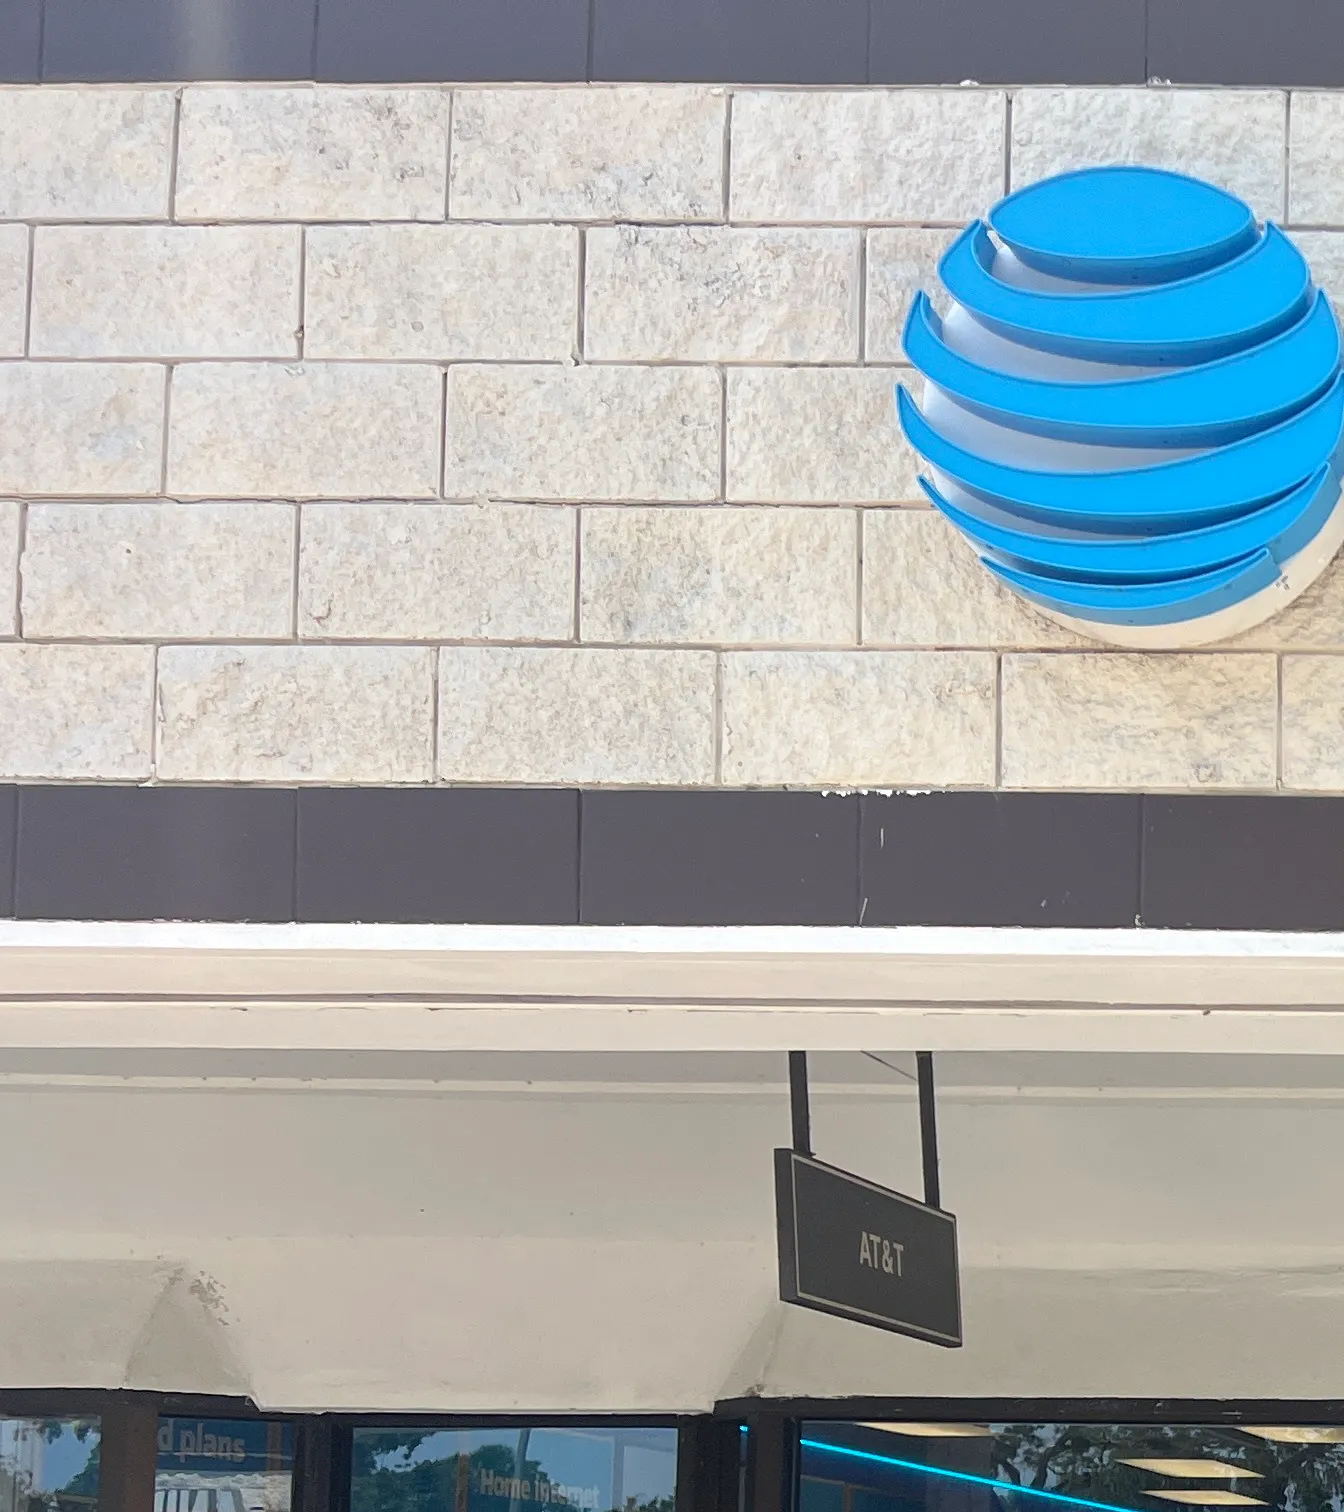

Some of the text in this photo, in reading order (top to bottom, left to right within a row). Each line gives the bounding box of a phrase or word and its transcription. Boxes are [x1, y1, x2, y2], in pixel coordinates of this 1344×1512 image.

[859, 1231, 905, 1277] AT&T
[180, 1422, 246, 1463] plans
[480, 1468, 531, 1500] Home
